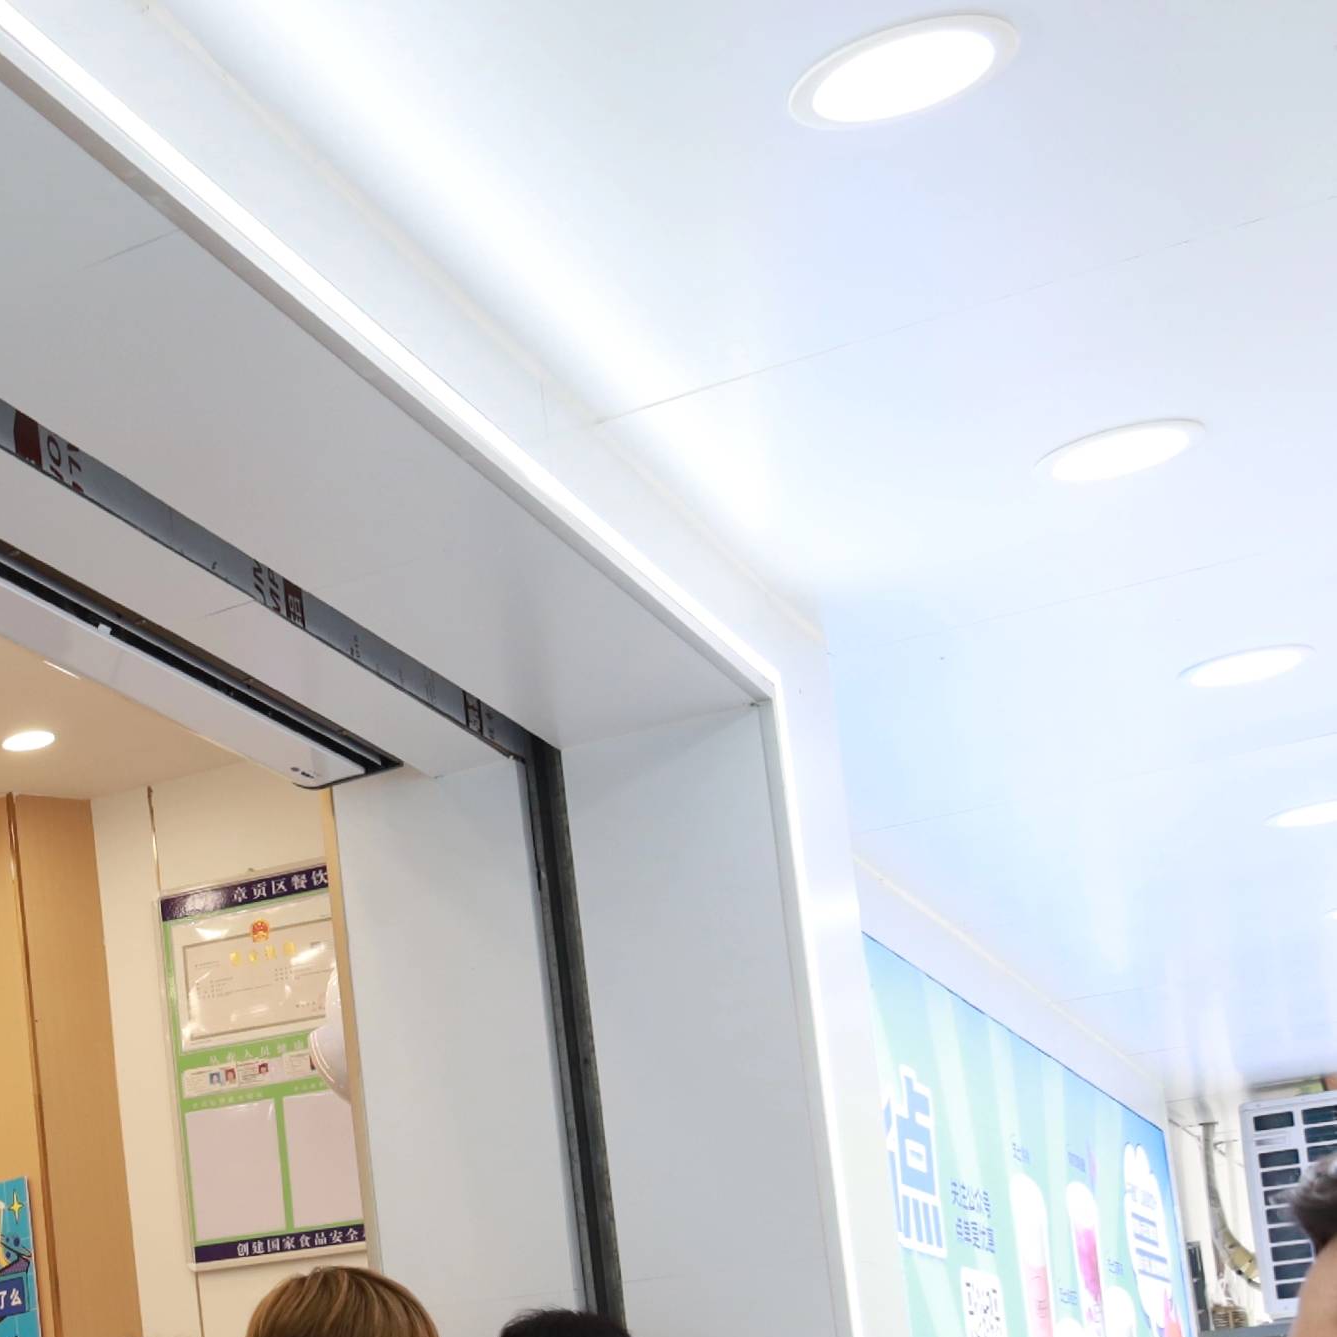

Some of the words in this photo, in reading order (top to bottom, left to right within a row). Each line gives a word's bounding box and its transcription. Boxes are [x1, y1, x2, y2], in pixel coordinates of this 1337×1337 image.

[237, 1226, 365, 1257] 创建国家食品安全
